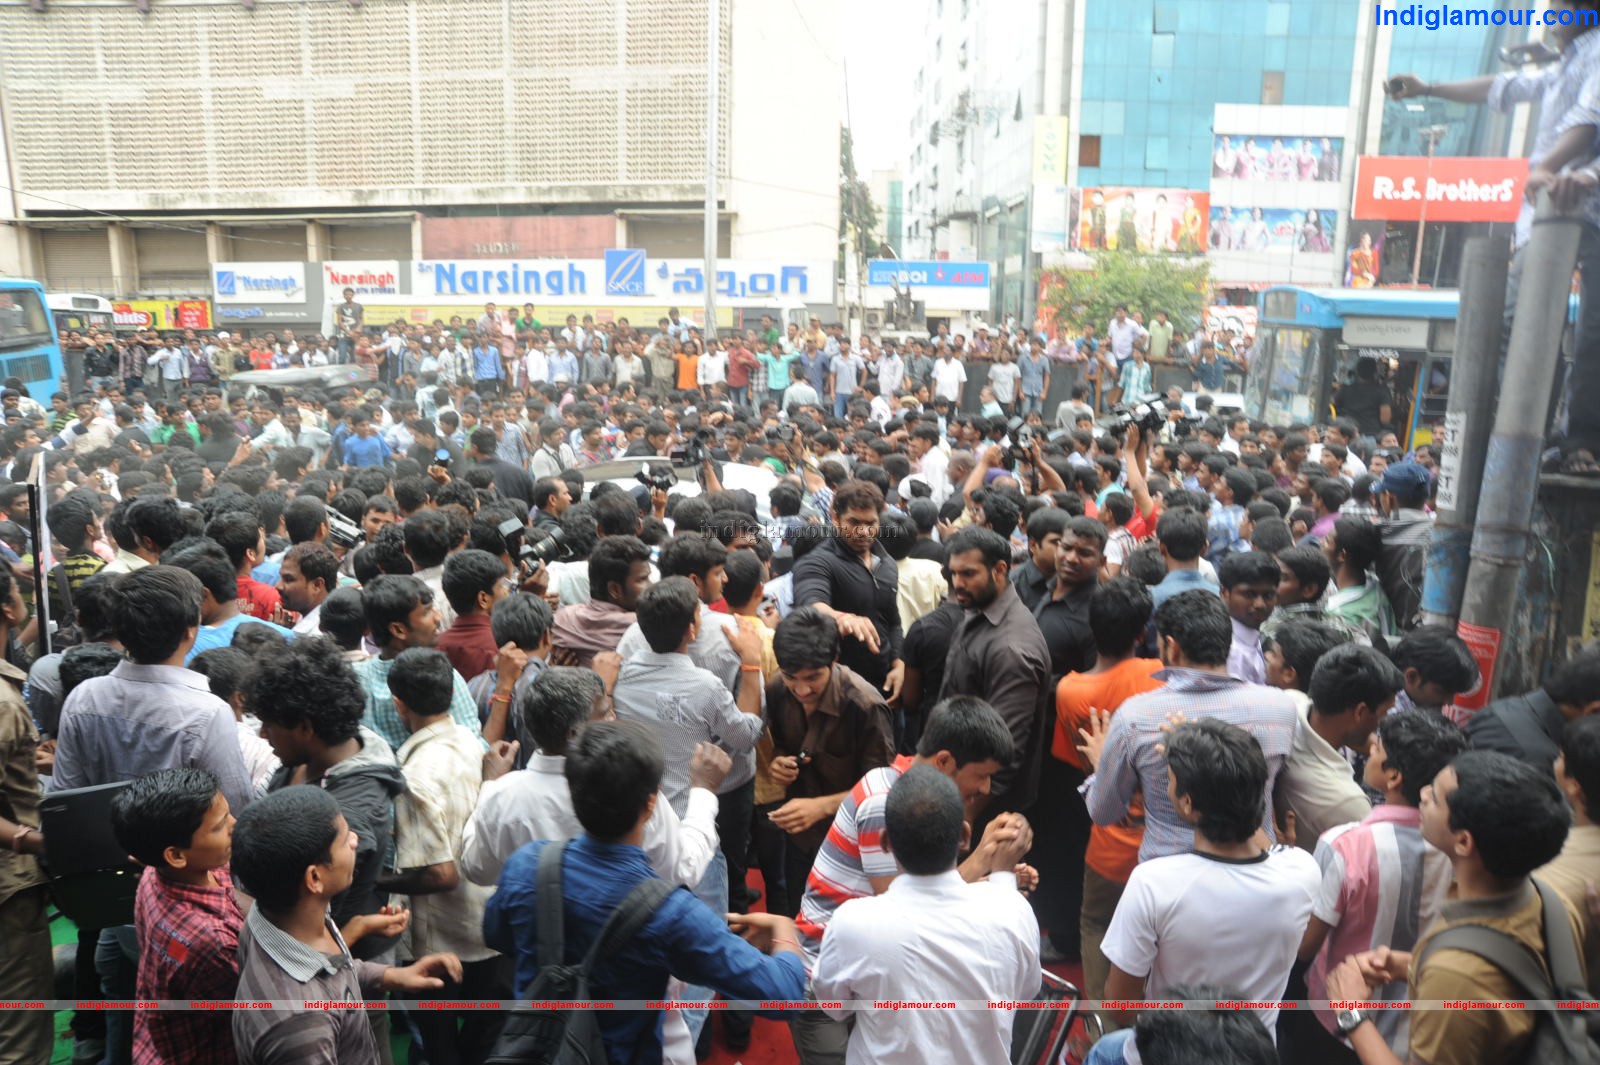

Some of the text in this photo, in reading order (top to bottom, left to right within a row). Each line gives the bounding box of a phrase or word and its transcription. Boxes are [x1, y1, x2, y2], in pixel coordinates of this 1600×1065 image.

[1373, 176, 1421, 201] R.S.
[330, 272, 395, 288] Narsingh
[435, 263, 586, 295] Narsingh
[951, 271, 984, 284] ATM
